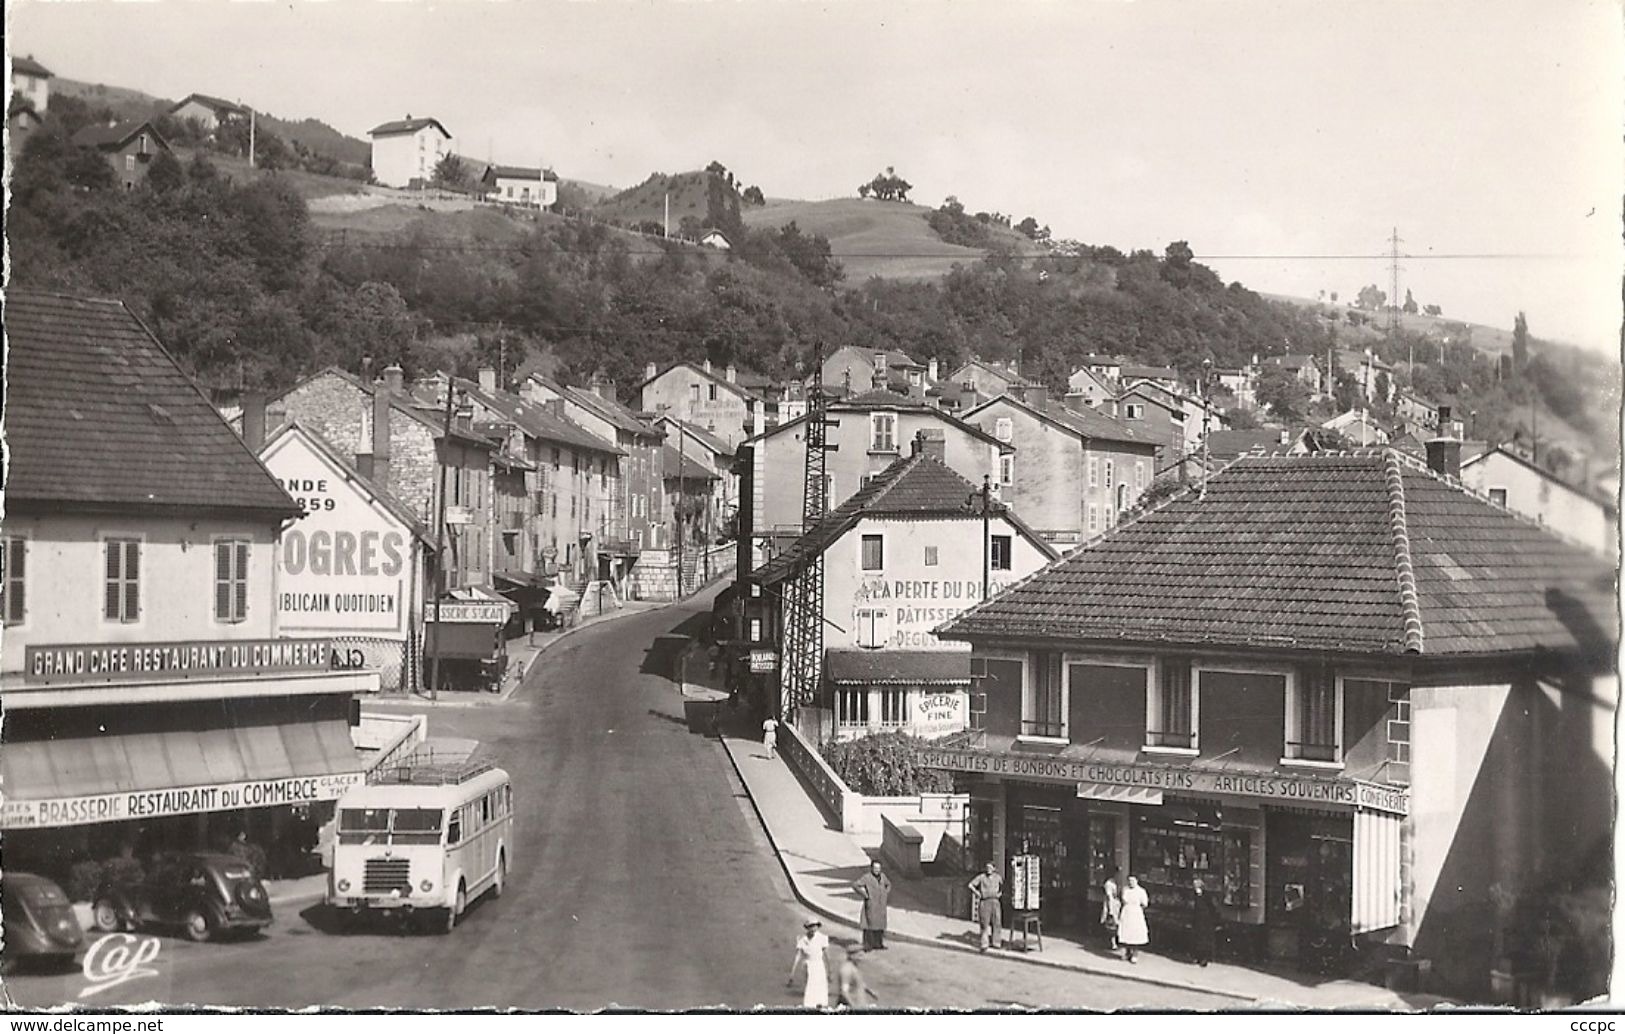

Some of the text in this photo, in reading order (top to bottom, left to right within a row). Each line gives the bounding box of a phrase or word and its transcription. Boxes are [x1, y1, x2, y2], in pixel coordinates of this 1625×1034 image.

[895, 580, 939, 599] PERTE
[943, 580, 962, 599] DU
[335, 594, 395, 613] QUOTIDIEN
[425, 606, 469, 619] BRSSERIE
[34, 650, 85, 675] GRAND
[133, 646, 226, 672] RESTAURANT
[232, 646, 249, 669] DU
[253, 642, 326, 667] COMMERCE
[927, 711, 953, 721] FINE
[993, 759, 1008, 772] DE
[1013, 760, 1068, 777] BONBONS
[1071, 764, 1085, 779] ET
[1088, 765, 1161, 786] CHOCOLATS
[1164, 772, 1194, 788] FINS
[1213, 777, 1275, 796] ARTICLES
[1280, 781, 1354, 801] SOUVENIRS
[39, 779, 318, 824] BRASSERIE RESTAURANT DU COMMERCE
